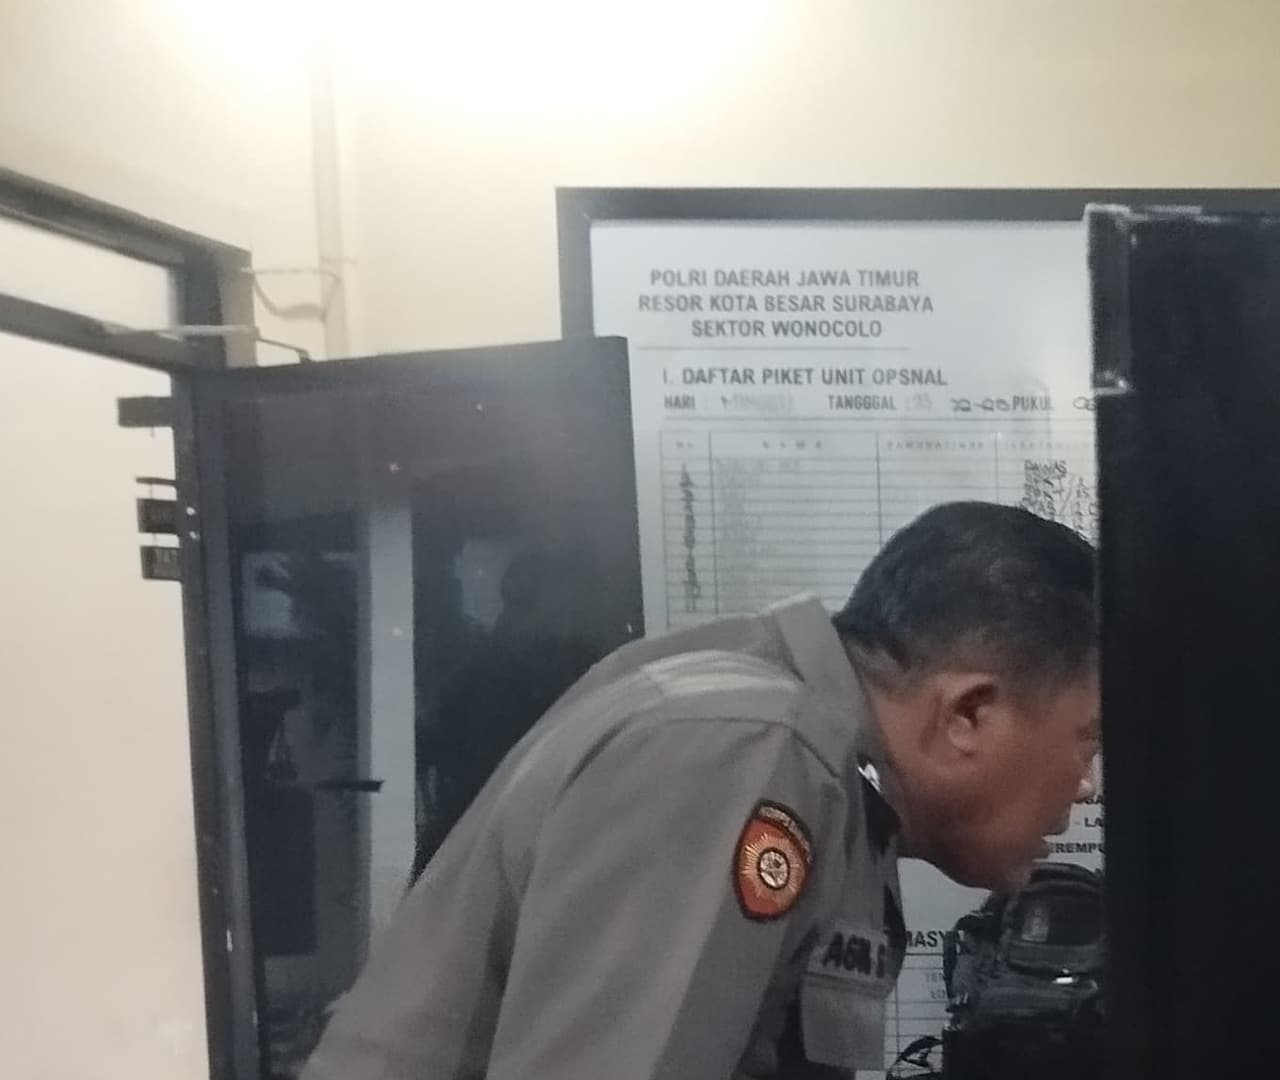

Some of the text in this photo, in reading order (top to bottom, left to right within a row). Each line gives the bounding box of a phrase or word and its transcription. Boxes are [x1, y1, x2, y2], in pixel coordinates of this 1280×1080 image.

[650, 270, 920, 287] POLRI DAERAH JAWA TIMUR
[639, 295, 934, 312] RESOR KOTA BESAR SURABAYA
[691, 320, 883, 337] SEKTOR WONOCOLO
[682, 368, 756, 385] DAFTAR
[762, 368, 814, 385] PIKET
[821, 368, 865, 385] UNIT
[872, 368, 948, 386] OPSNAL
[664, 394, 696, 410] HARI
